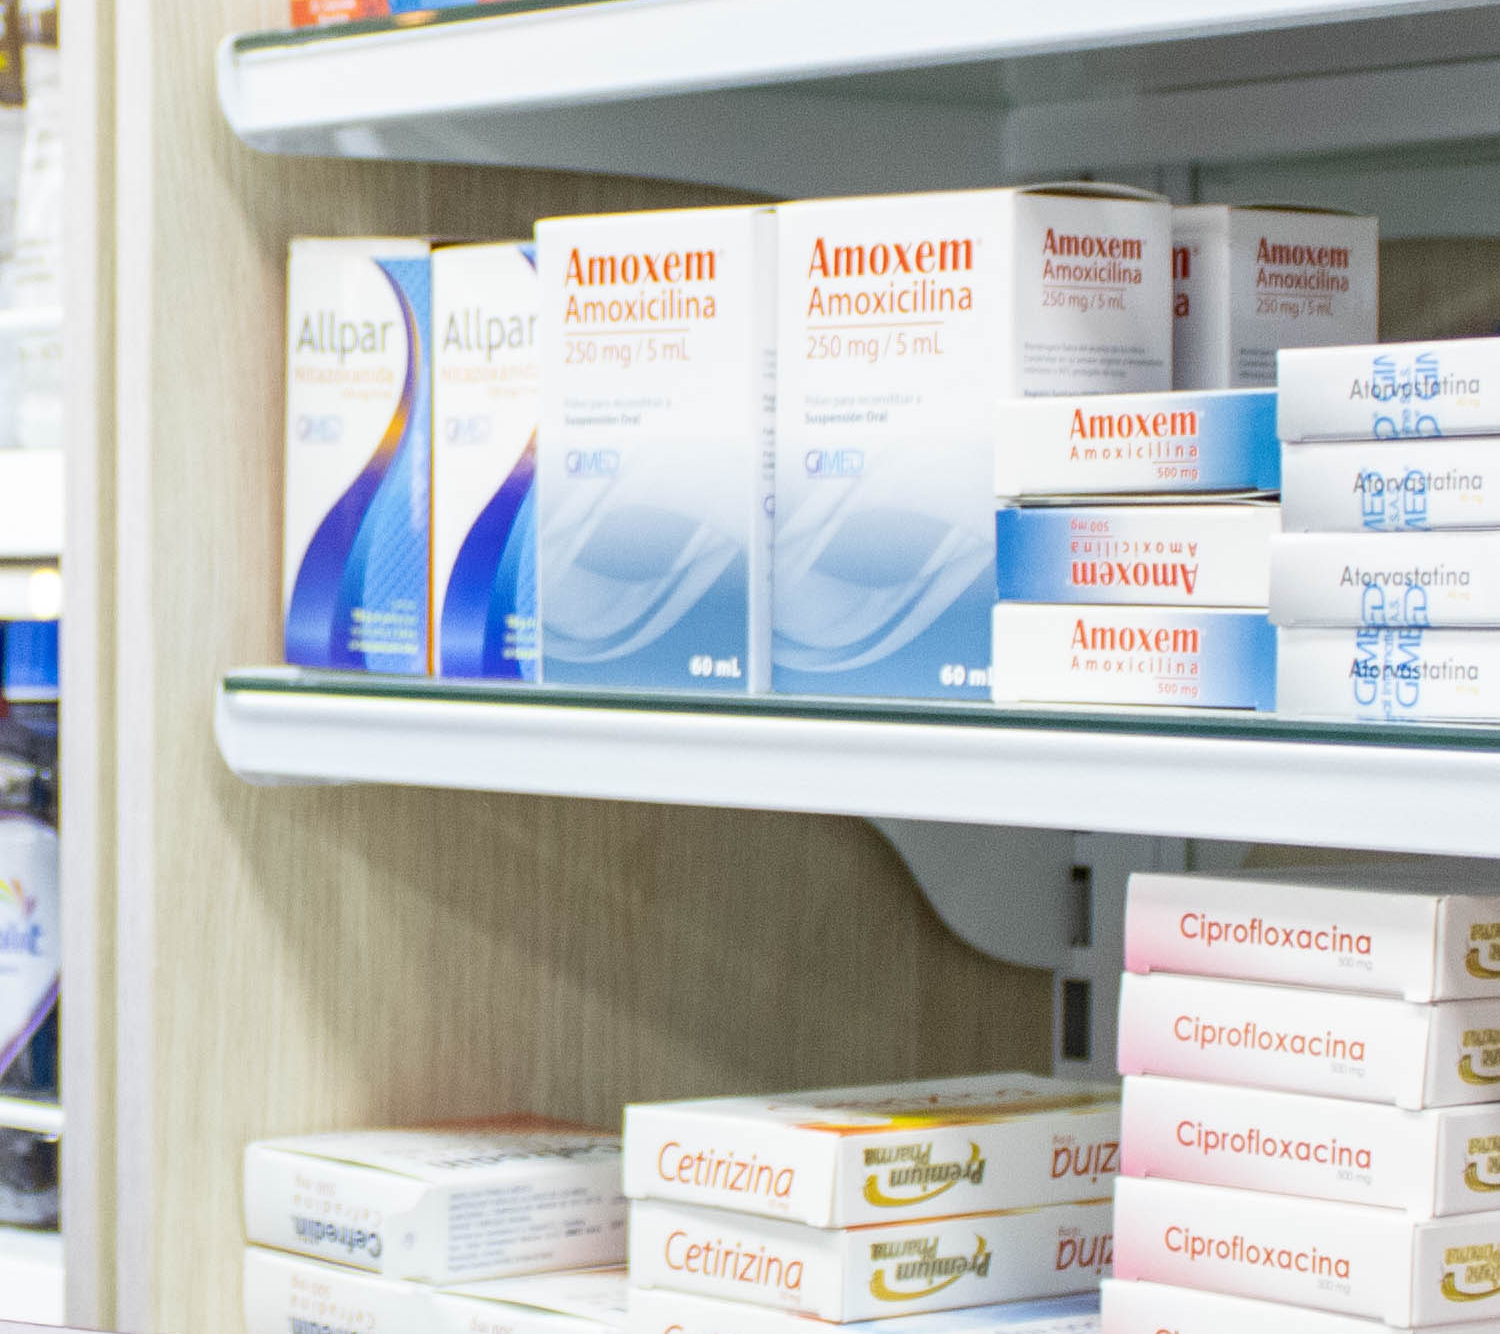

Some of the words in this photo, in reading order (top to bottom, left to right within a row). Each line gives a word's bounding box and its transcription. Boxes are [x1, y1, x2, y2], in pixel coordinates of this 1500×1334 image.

[808, 235, 974, 280] Amoxem
[1042, 227, 1143, 261] Amoxem
[1042, 257, 1143, 285] Amoxicilina
[807, 280, 973, 317] Amoxicilina
[295, 310, 396, 359] Allpar
[806, 333, 841, 359] 250
[847, 333, 878, 364] mg
[896, 332, 907, 356] 5
[912, 329, 943, 355] mL
[1070, 409, 1198, 439] Amoxem
[1070, 441, 1199, 461] Amoxicilina
[1157, 467, 1177, 479] 500
[1180, 469, 1199, 482] mg
[1071, 540, 1198, 557] Amoxicilina
[1071, 561, 1198, 595] Amoxem
[1340, 565, 1471, 587] Atorvastatina
[1179, 912, 1372, 958] Ciprofloxacina
